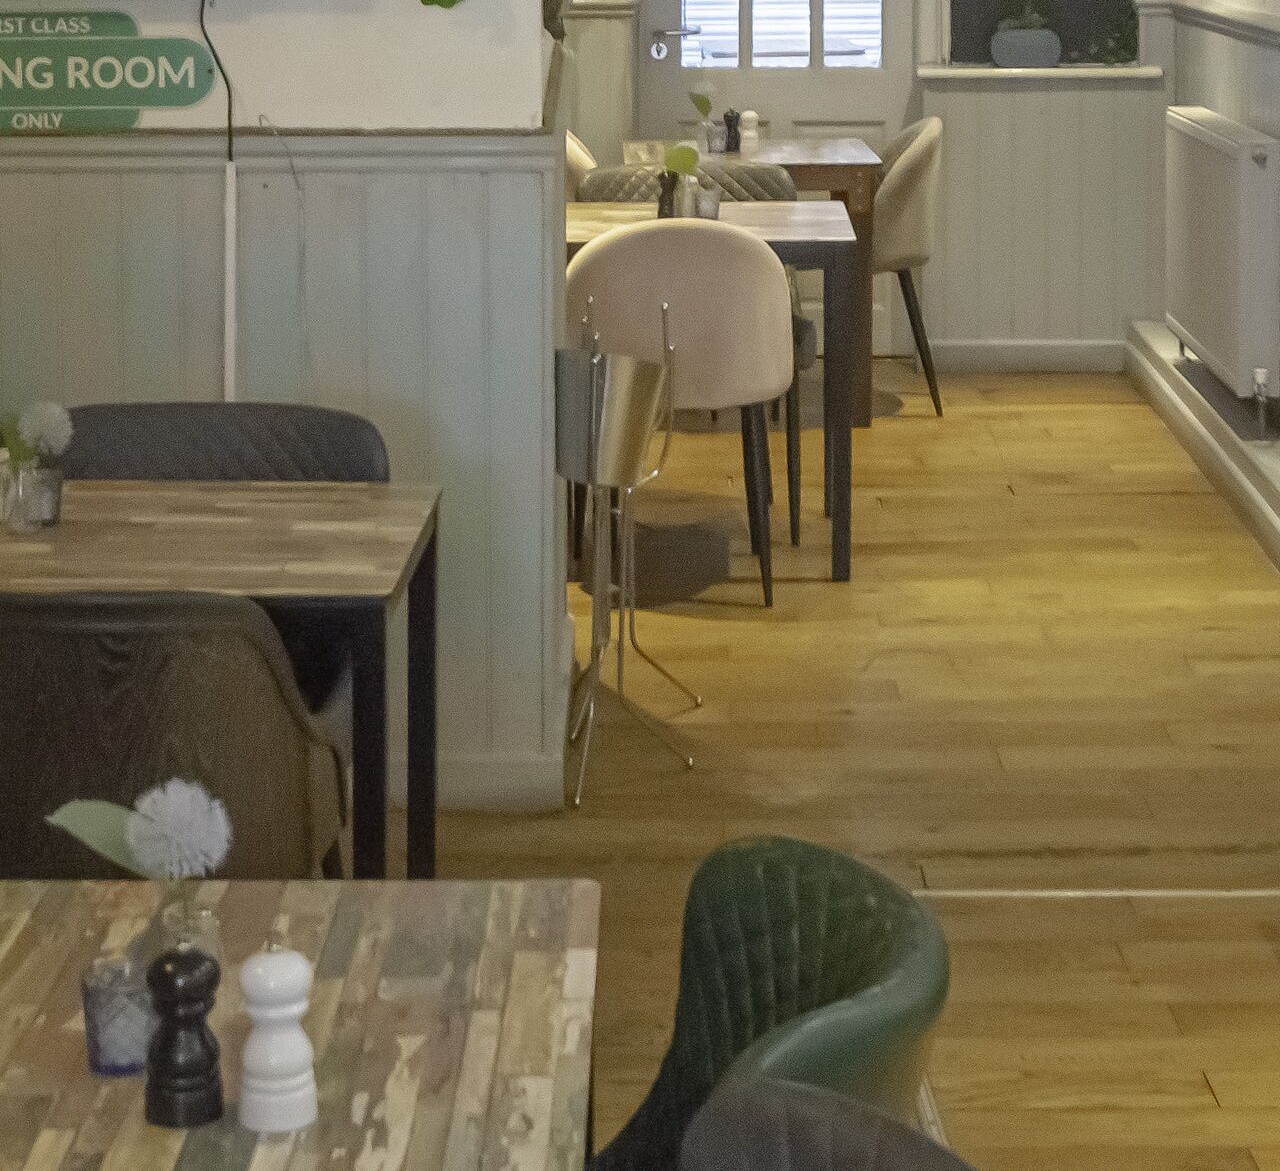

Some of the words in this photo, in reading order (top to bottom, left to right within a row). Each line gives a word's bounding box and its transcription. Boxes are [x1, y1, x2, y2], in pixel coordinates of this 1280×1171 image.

[30, 17, 91, 34] CLASS
[67, 56, 197, 90] ROOM
[11, 113, 63, 130] ONLY
